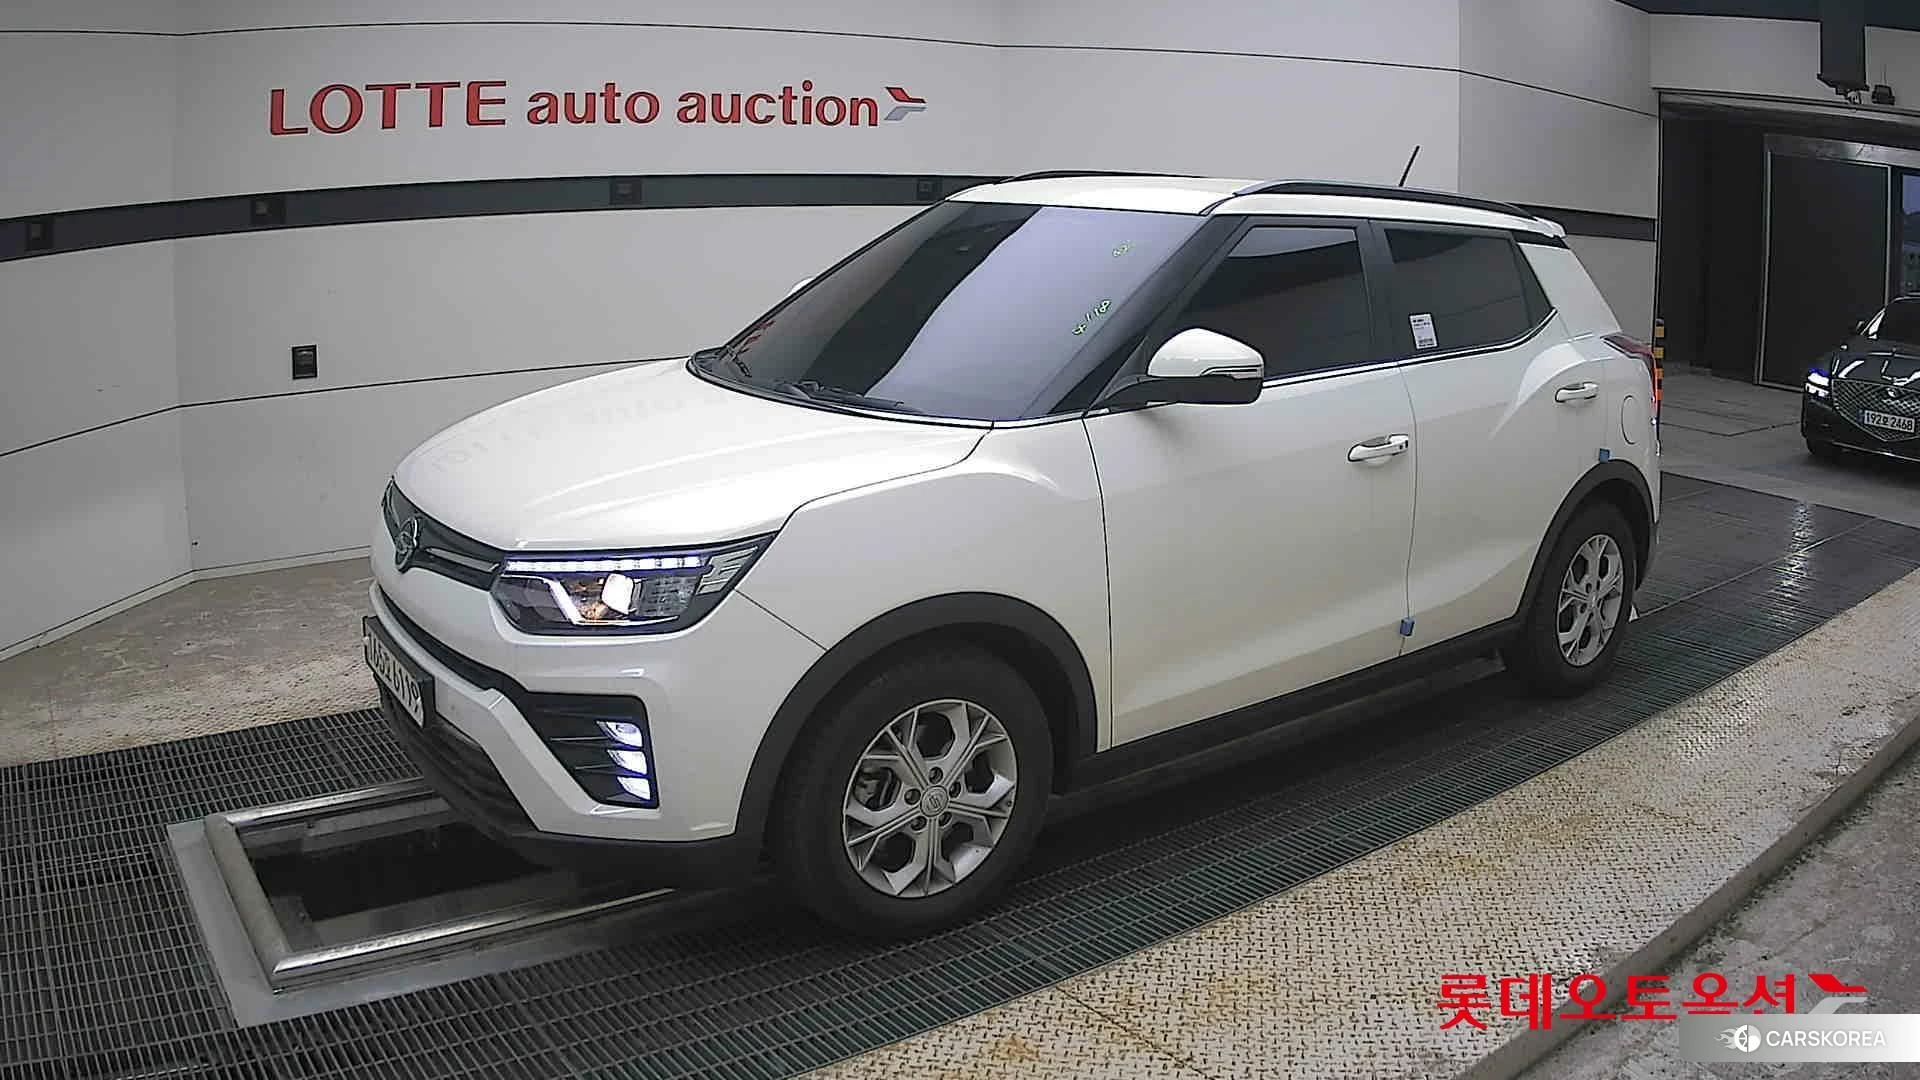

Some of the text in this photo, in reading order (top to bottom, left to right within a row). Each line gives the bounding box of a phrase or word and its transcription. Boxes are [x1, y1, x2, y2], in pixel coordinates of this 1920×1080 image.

[269, 80, 880, 136] LOTTE auto auction
